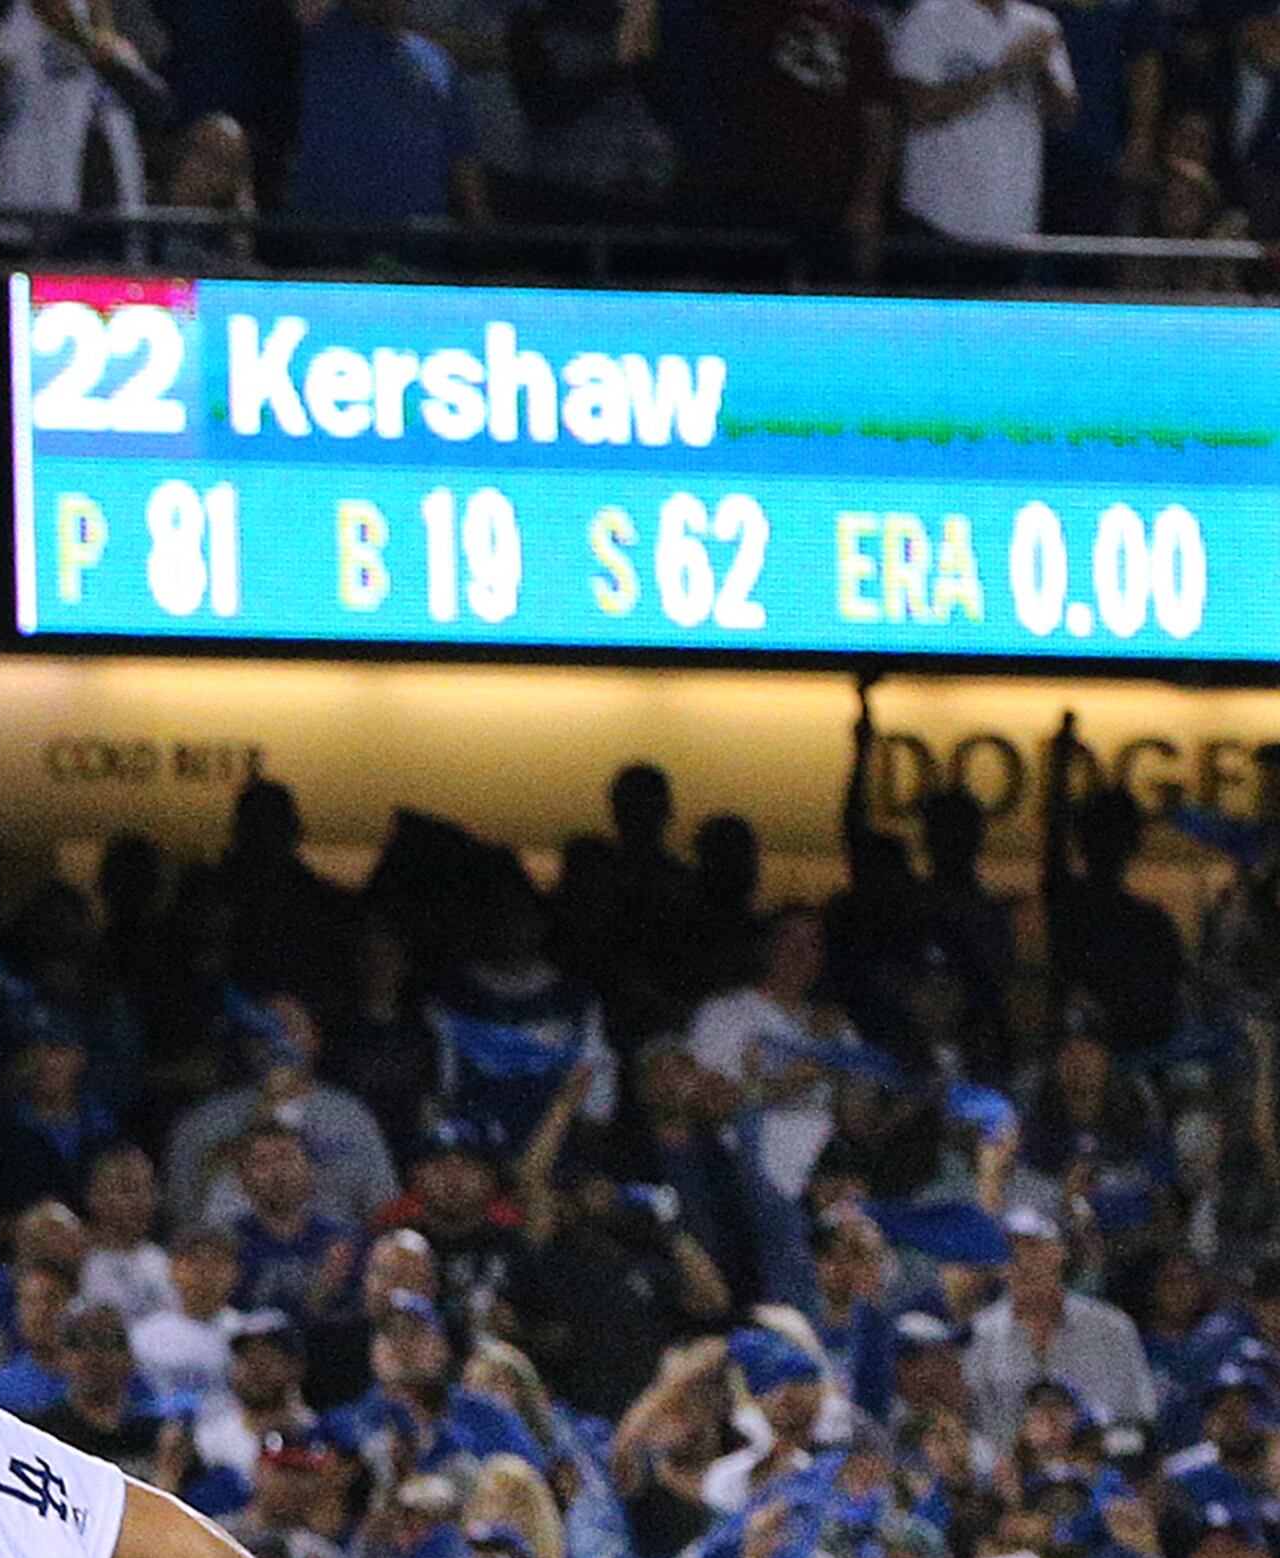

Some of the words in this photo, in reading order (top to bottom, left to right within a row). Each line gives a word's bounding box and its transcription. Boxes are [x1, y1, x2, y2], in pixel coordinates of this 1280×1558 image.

[32, 302, 186, 433] 22
[227, 313, 726, 446] Kershaw
[58, 492, 108, 603] P
[147, 479, 237, 617] 81
[338, 501, 391, 612] B
[422, 486, 522, 624] 19
[589, 505, 639, 616] S
[655, 492, 770, 628] 62
[835, 511, 985, 623] ERA
[1010, 500, 1206, 638] 0.00
